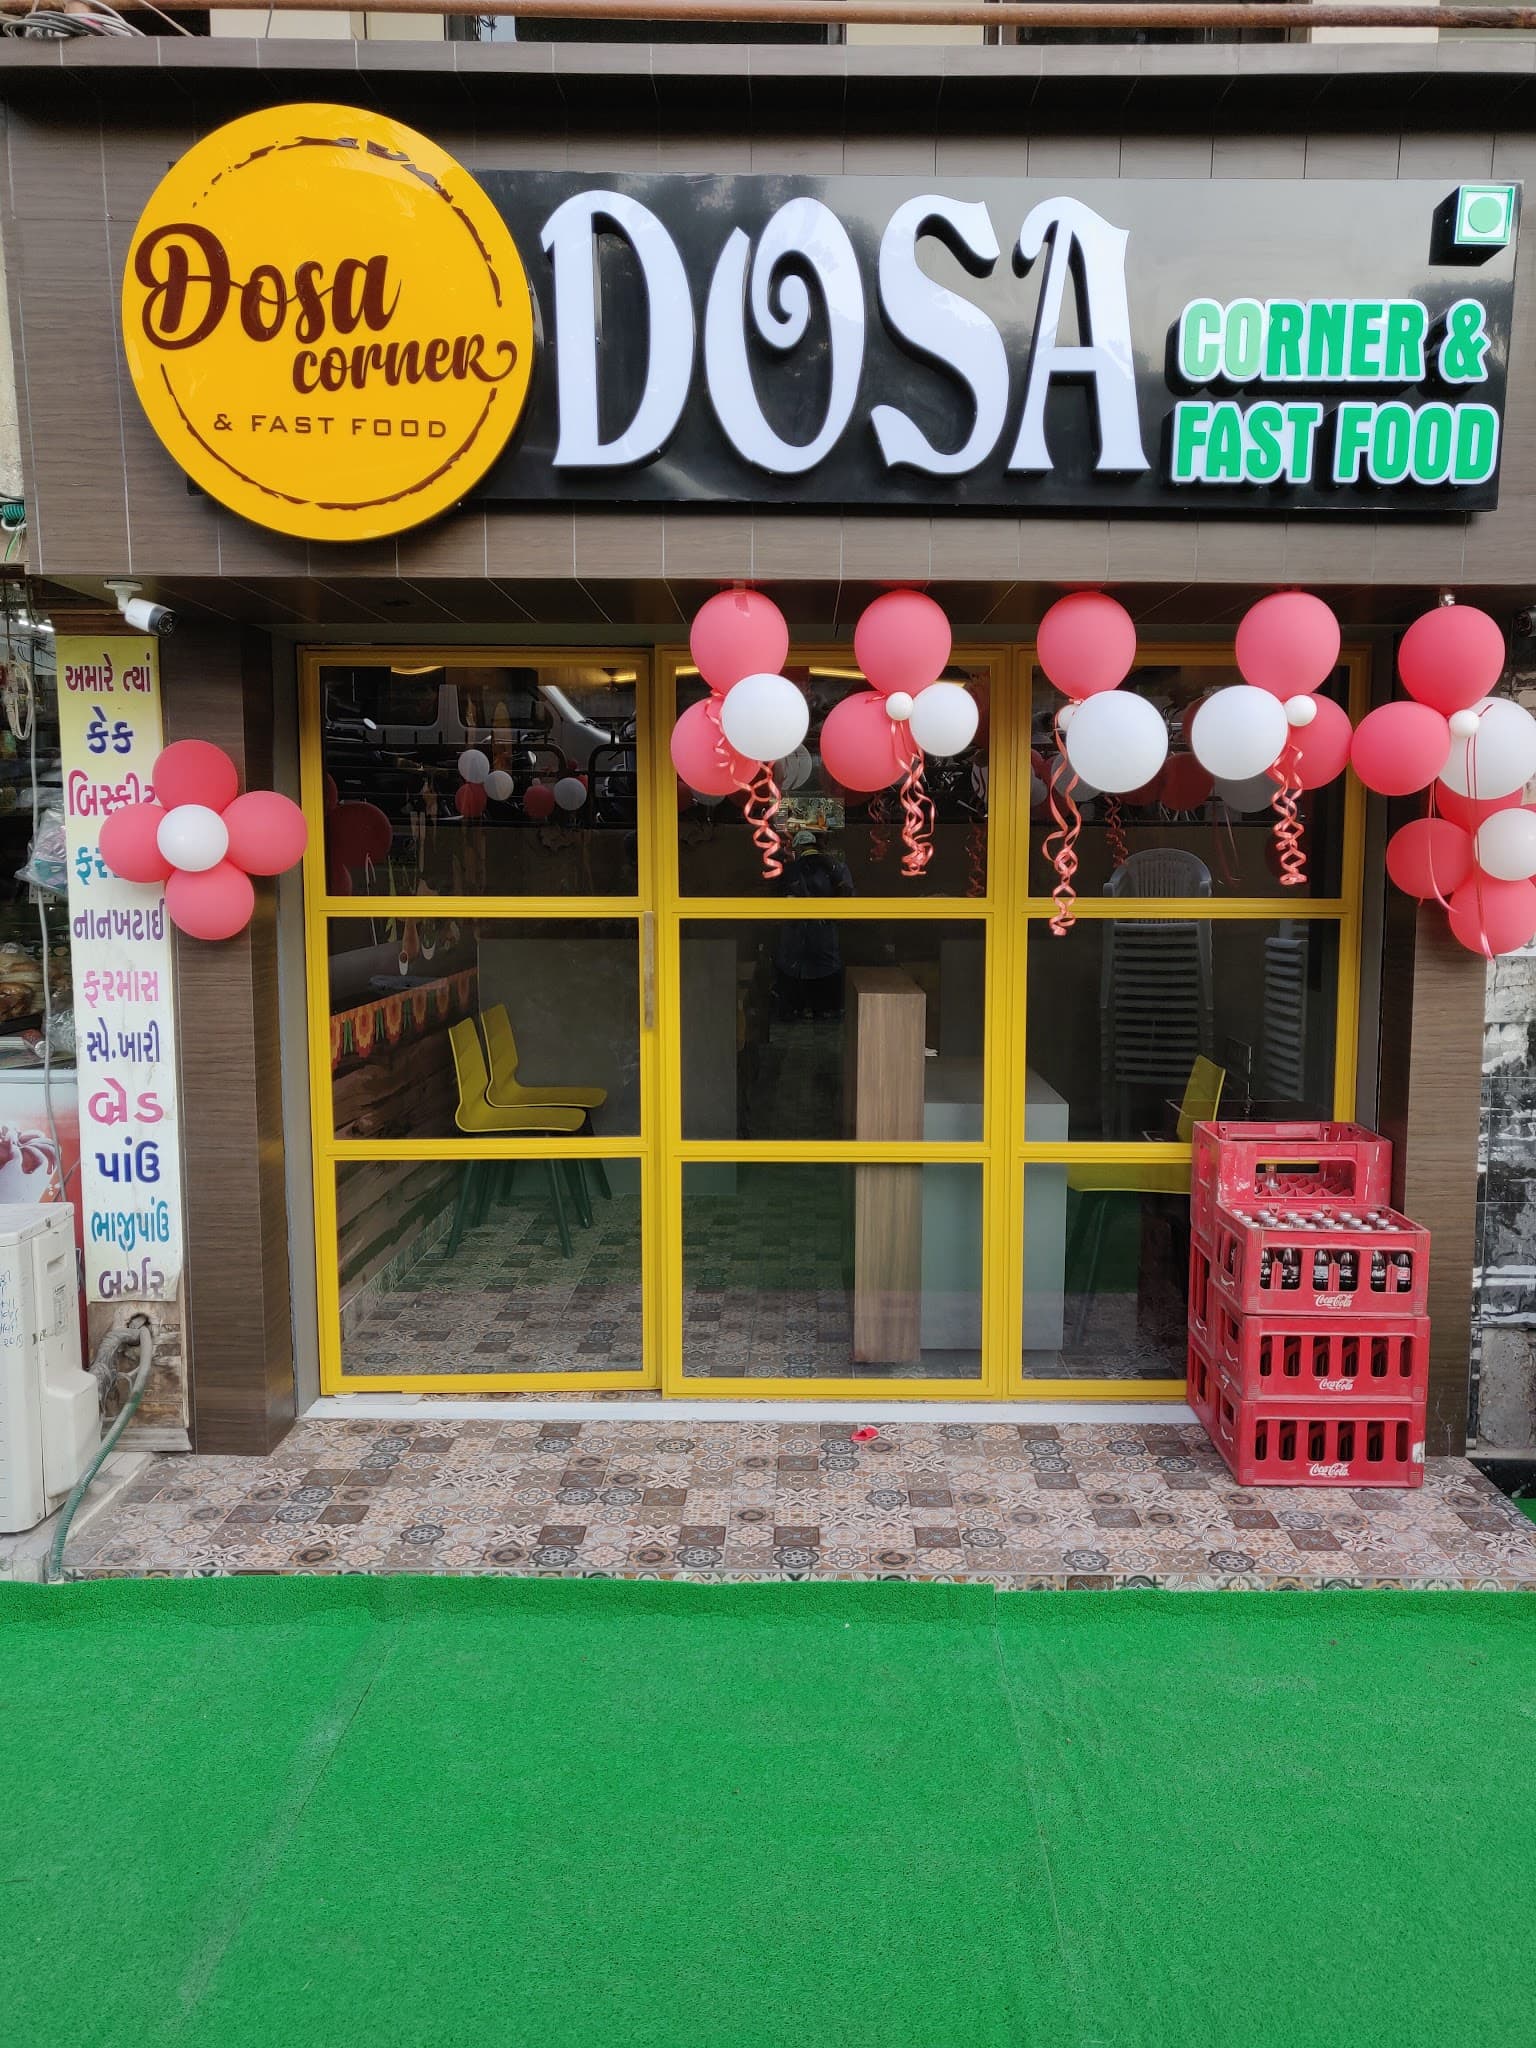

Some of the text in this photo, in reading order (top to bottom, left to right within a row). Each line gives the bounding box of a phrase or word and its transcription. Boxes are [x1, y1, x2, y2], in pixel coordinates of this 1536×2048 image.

[134, 222, 402, 351] Dosa
[539, 190, 1151, 475] DOSA
[1178, 298, 1491, 384] CORNER &
[213, 413, 447, 438] & FAST FOOD
[1171, 401, 1500, 486] FAST FOOD
[65, 652, 151, 692] અમારે ત્યાં
[86, 706, 134, 754] કેક
[73, 898, 166, 941] નાનખટાઈ
[87, 1077, 164, 1126] બ્રેડ
